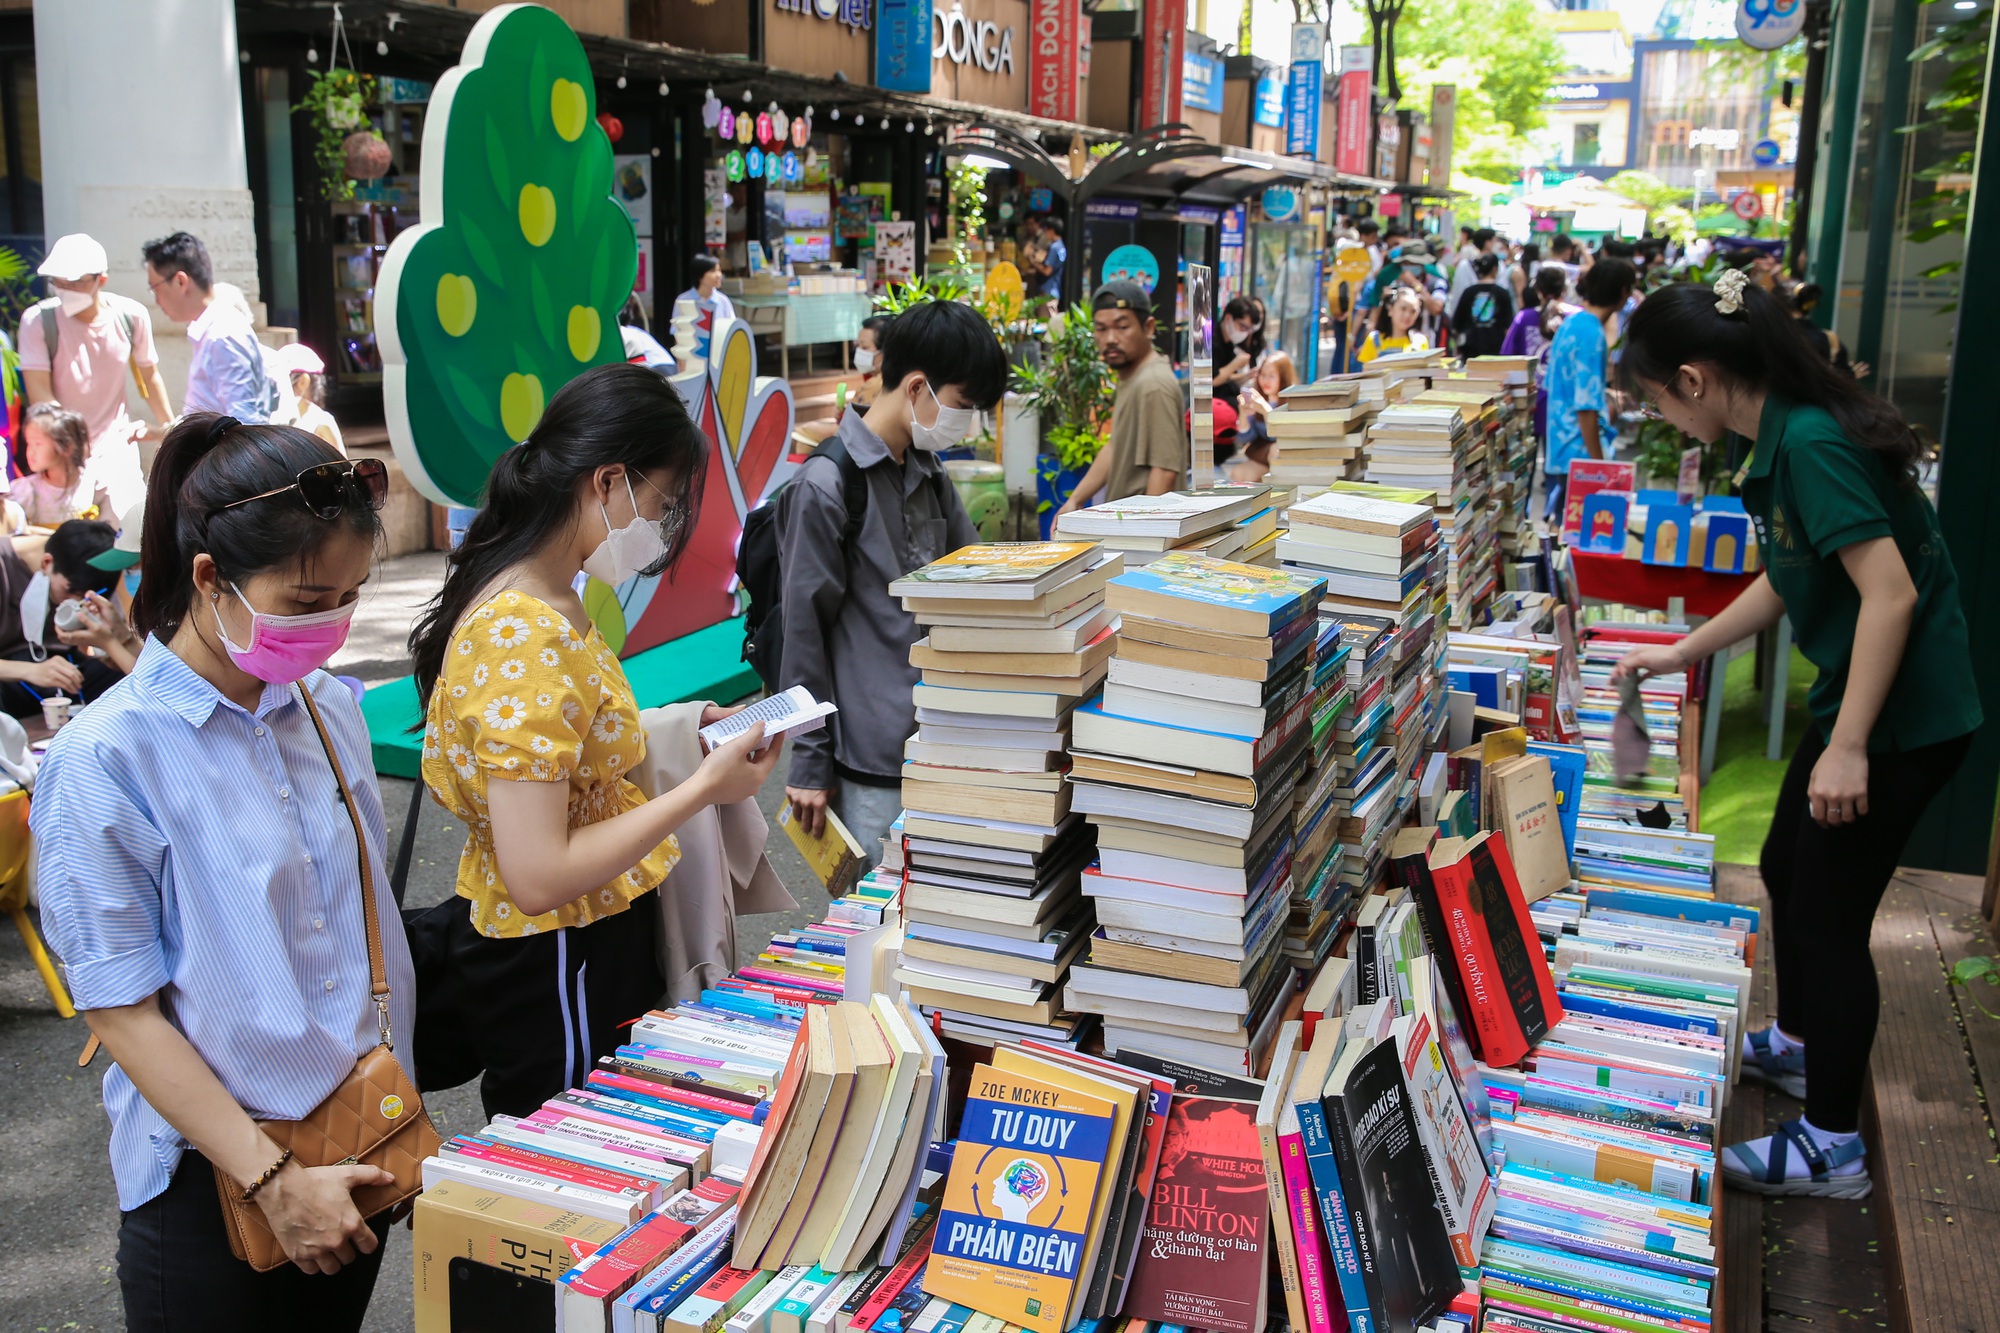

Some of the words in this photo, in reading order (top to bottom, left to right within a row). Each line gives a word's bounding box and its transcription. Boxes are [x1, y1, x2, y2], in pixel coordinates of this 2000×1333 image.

[1039, 62, 1058, 117] SÁCH
[1452, 907, 1463, 922] 48
[1464, 952, 1481, 985] QUYỀN
[775, 998, 790, 1008] SEE
[1162, 1063, 1173, 1071] Brad
[1174, 1066, 1190, 1075] Schepp
[1194, 1070, 1208, 1078] Debra
[1210, 1075, 1227, 1084] Schepp
[980, 1082, 1007, 1100] ZOE
[1012, 1087, 1060, 1107] MCKEY
[1364, 1102, 1380, 1131] DẠO
[1378, 1090, 1390, 1117] KÍ
[1387, 1083, 1401, 1108] SỰ
[991, 1109, 1025, 1142] TƯ
[1023, 1114, 1076, 1150] DUY
[1312, 1113, 1325, 1139] Michael
[1576, 1111, 1608, 1122] LUẬT
[1612, 1118, 1645, 1131] CHƠI
[1307, 1125, 1317, 1147] Young
[1202, 1157, 1237, 1172] WHITE
[1240, 1162, 1265, 1175] HOU
[1154, 1183, 1217, 1210] BILL
[1301, 1188, 1310, 1207] TONY
[1421, 1145, 1434, 1168] PHƯƠNG
[1441, 1203, 1451, 1217] SIÊU
[1447, 1216, 1456, 1229] TỐC
[1149, 1204, 1259, 1239] LINTON
[1303, 1208, 1314, 1233] BUZAN
[1323, 1197, 1333, 1220] Bringing
[1328, 1221, 1340, 1249] Knowledge
[1335, 1249, 1344, 1261] Back
[1335, 1218, 1347, 1234] LẠI
[1354, 1211, 1365, 1232] CODE
[948, 1219, 1016, 1262] PHẢN
[1017, 1233, 1077, 1274] BIỆN
[1143, 1226, 1173, 1242] hặng
[1177, 1229, 1214, 1248] đường
[1217, 1237, 1233, 1249] cơ
[1235, 1237, 1258, 1253] hàn
[1340, 1234, 1351, 1249] TRI
[1359, 1233, 1368, 1251] DẠO
[1559, 1231, 1571, 1239] 100
[1572, 1233, 1590, 1242] CÂU
[1592, 1238, 1626, 1250] CHUYỆN
[1150, 1239, 1170, 1260] &
[1168, 1242, 1202, 1258] thành
[1205, 1247, 1226, 1262] đạt
[1509, 1251, 1531, 1260] WOOD
[1305, 1253, 1318, 1275] SÁCH
[1344, 1249, 1358, 1275] THỨC
[1365, 1261, 1374, 1274] SỰ
[1552, 1259, 1591, 1271] MICROSOFT
[1307, 1276, 1319, 1289] DẠY
[1480, 1266, 1507, 1278] KHÔNG
[1508, 1271, 1526, 1280] BAO
[1528, 1274, 1542, 1284] GIỜ
[1559, 1281, 1580, 1292] THẤT
[1581, 1287, 1596, 1297] BẠI
[1602, 1291, 1619, 1301] TẤT
[1667, 1307, 1698, 1320] THÁCH
[1165, 1292, 1178, 1301] TÁI
[1311, 1289, 1321, 1302] ĐỌC
[1165, 1301, 1191, 1312] VƯƠNG
[1313, 1303, 1325, 1325] NHANH
[1579, 1300, 1596, 1310] QUY
[1596, 1304, 1609, 1313] LUẬT
[1609, 1306, 1624, 1316] CỦA
[1634, 1311, 1647, 1321] NỔI
[1647, 1314, 1665, 1326] LOẠN
[1520, 1321, 1538, 1330] DALE
[1568, 1315, 1580, 1324] SỰ
[1581, 1318, 1596, 1328] SỤP
